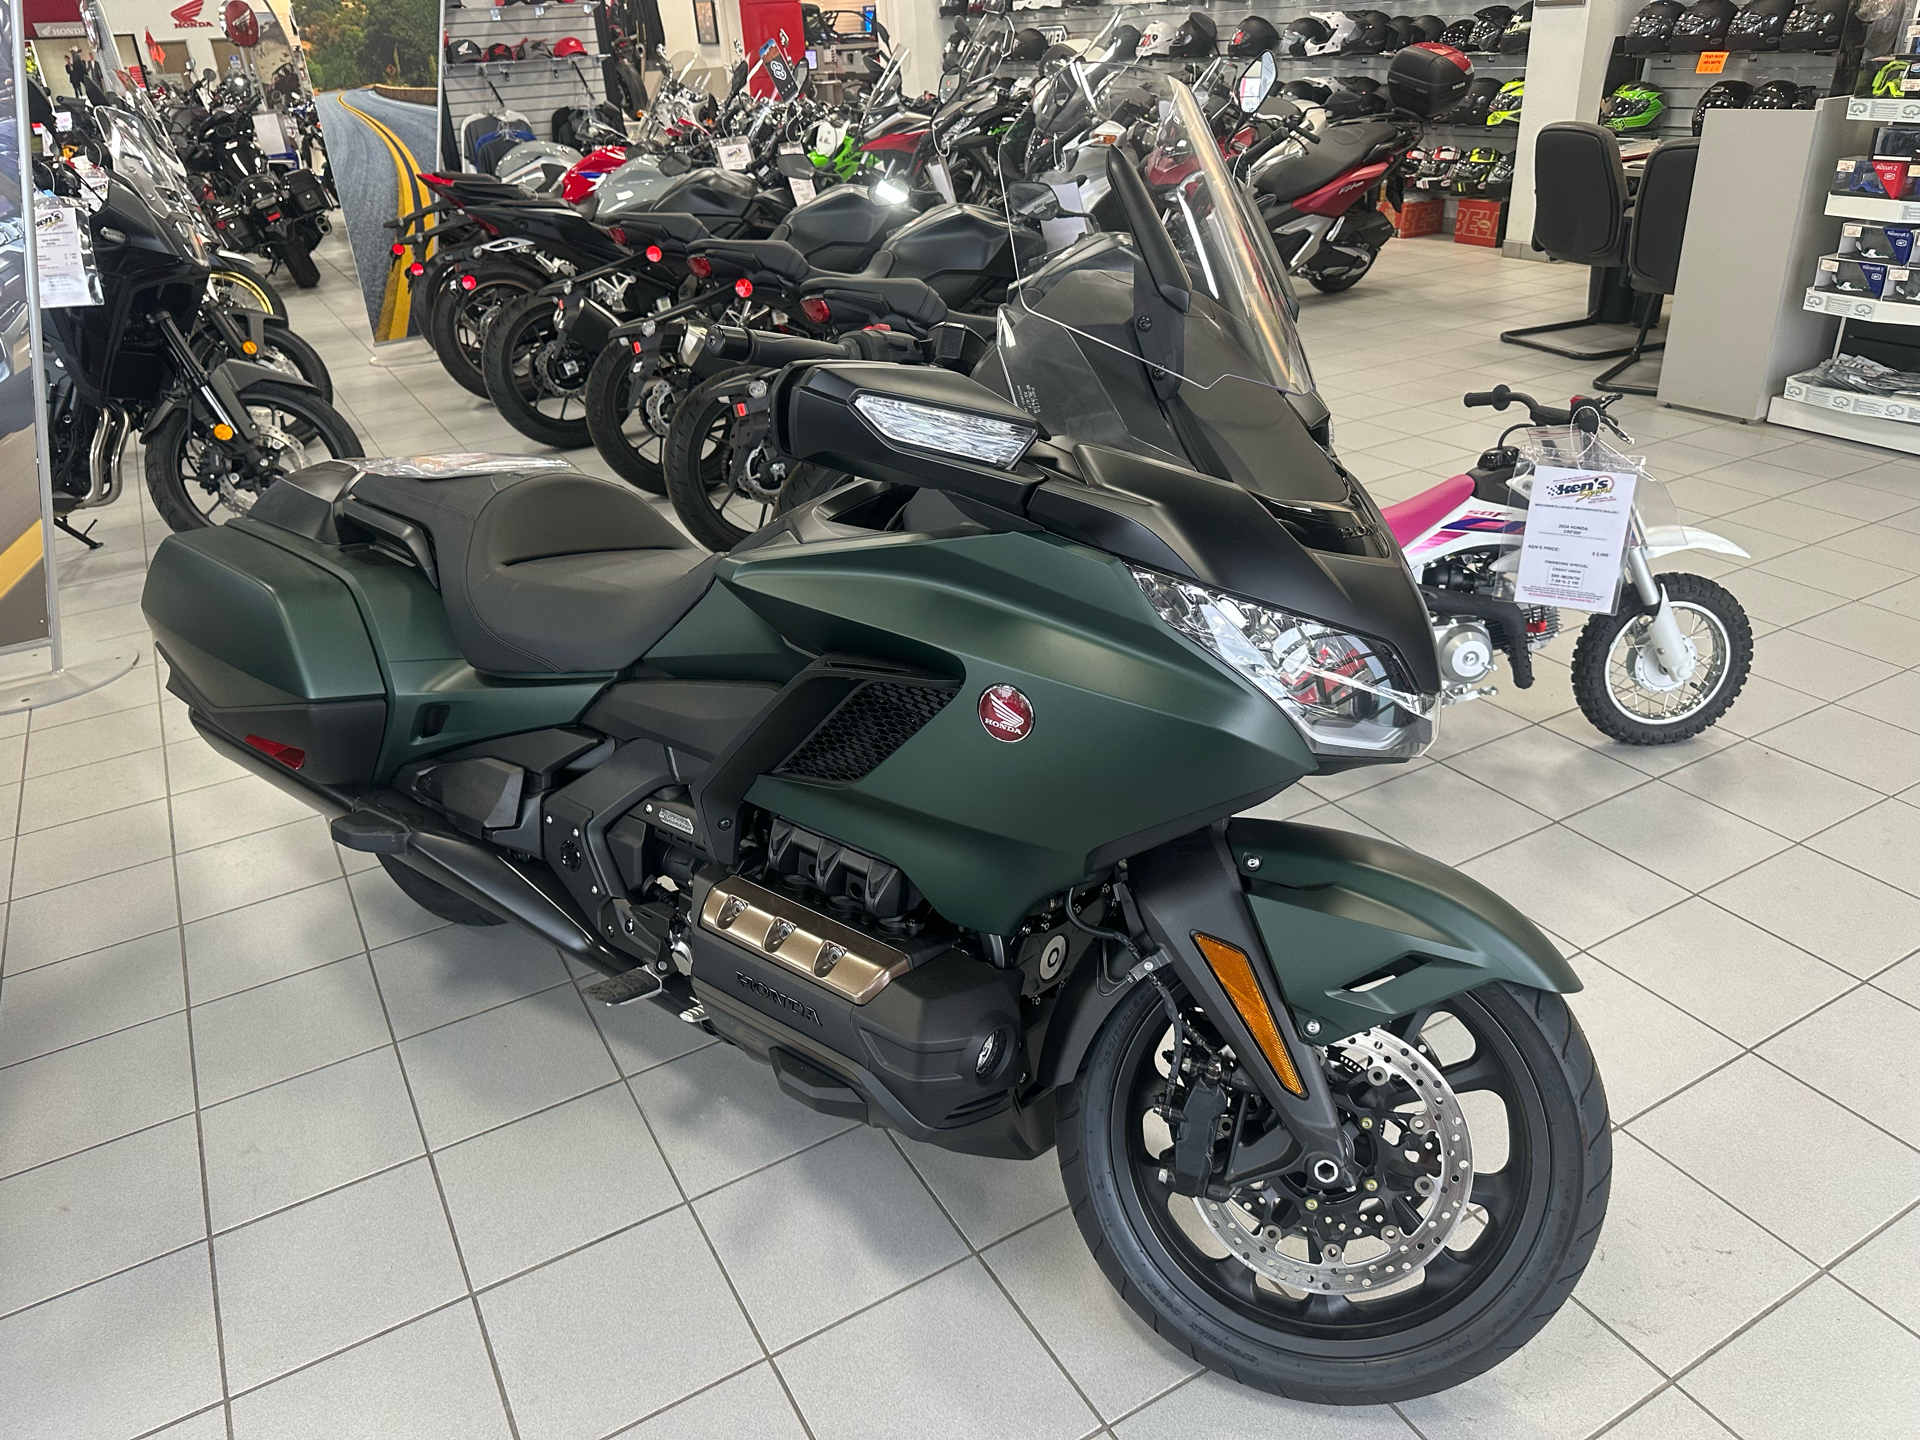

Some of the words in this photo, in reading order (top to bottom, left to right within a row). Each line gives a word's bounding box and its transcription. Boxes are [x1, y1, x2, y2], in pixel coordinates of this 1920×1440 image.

[173, 20, 214, 29] HONDA
[985, 718, 1022, 735] HONDA
[735, 970, 823, 1027] HONDA
